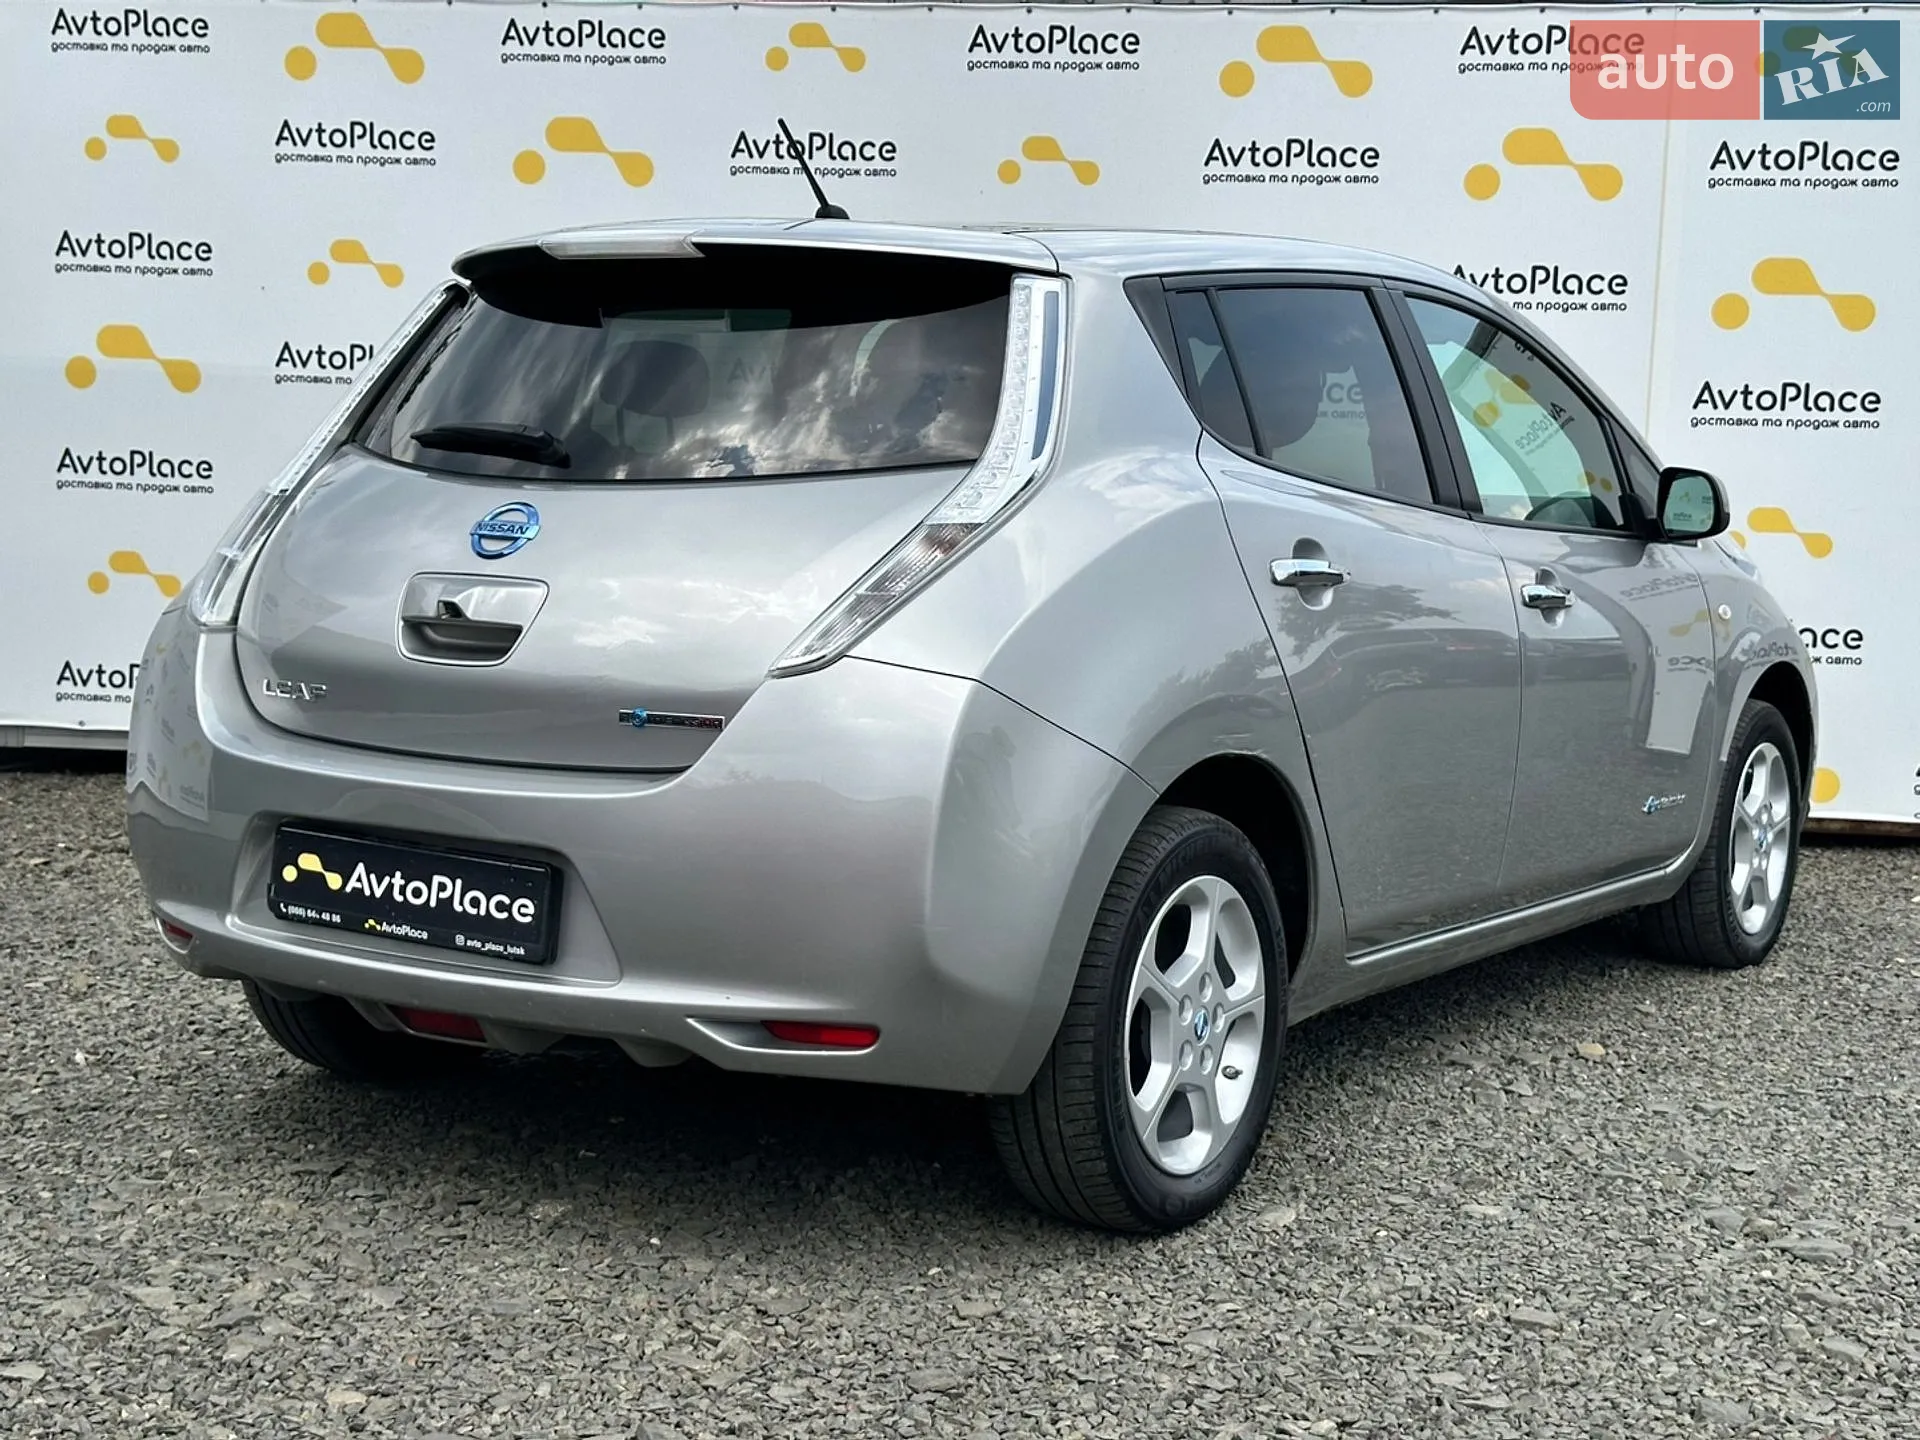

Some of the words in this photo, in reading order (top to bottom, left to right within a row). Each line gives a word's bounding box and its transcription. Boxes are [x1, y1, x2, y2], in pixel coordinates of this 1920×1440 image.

[51, 7, 209, 39] AvtoPlace
[501, 17, 666, 49] AvtoPlace
[967, 23, 1141, 55] AvtoPlace
[1459, 24, 1645, 56] AvtoPlace
[50, 41, 109, 53] доставка
[110, 43, 129, 52] та
[131, 43, 177, 55] продаж
[178, 43, 211, 54] авто
[500, 52, 561, 65] доставка
[563, 54, 582, 63] та
[583, 54, 631, 67] продаж
[633, 55, 667, 65] авто
[966, 60, 1029, 72] доставка
[1031, 60, 1051, 70] та
[1053, 61, 1103, 73] продаж
[1105, 61, 1140, 71] авто
[1457, 61, 1525, 75] доставка
[1527, 61, 1548, 71] та
[275, 119, 436, 151] AvtoPlace
[730, 130, 897, 162] AvtoPlace
[1203, 137, 1380, 169] AvtoPlace
[274, 152, 333, 164] доставка
[335, 154, 354, 164] та
[356, 155, 402, 167] продаж
[404, 157, 437, 167] авто
[1709, 140, 1901, 172] AvtoPlace
[729, 165, 791, 177] доставка
[814, 167, 861, 179] продаж
[863, 167, 897, 178] авто
[1202, 173, 1266, 185] доставка
[1268, 174, 1289, 183] та
[1291, 174, 1342, 186] продаж
[1344, 174, 1379, 184] авто
[1707, 177, 1777, 189] доставка
[1779, 177, 1801, 187] та
[1804, 178, 1859, 190] продаж
[1861, 178, 1899, 188] авто
[55, 229, 213, 262] AvtoPlace
[54, 263, 112, 274] доставка
[114, 265, 133, 274] та
[134, 265, 179, 277] продаж
[181, 267, 213, 277] авто
[1512, 301, 1533, 311] та
[1535, 301, 1588, 313] продаж
[1590, 302, 1627, 311] авто
[275, 341, 374, 371] AvtoPl
[274, 373, 333, 385] доставка
[335, 376, 353, 385] та
[1692, 380, 1882, 413] AvtoPlace
[1690, 416, 1759, 428] доставка
[1761, 418, 1783, 427] та
[1785, 418, 1840, 431] продаж
[1842, 419, 1880, 429] авто
[56, 447, 213, 480] AvtoPlace
[55, 479, 113, 490] доставка
[115, 481, 134, 491] та
[135, 483, 180, 495] продаж
[183, 485, 214, 494] авто
[476, 522, 531, 536] NISSAN
[55, 691, 112, 703] доставка
[114, 695, 131, 703] та
[262, 679, 328, 701] LEAF
[345, 861, 536, 923] AvtoPlace
[381, 921, 429, 940] AvtoPlace
